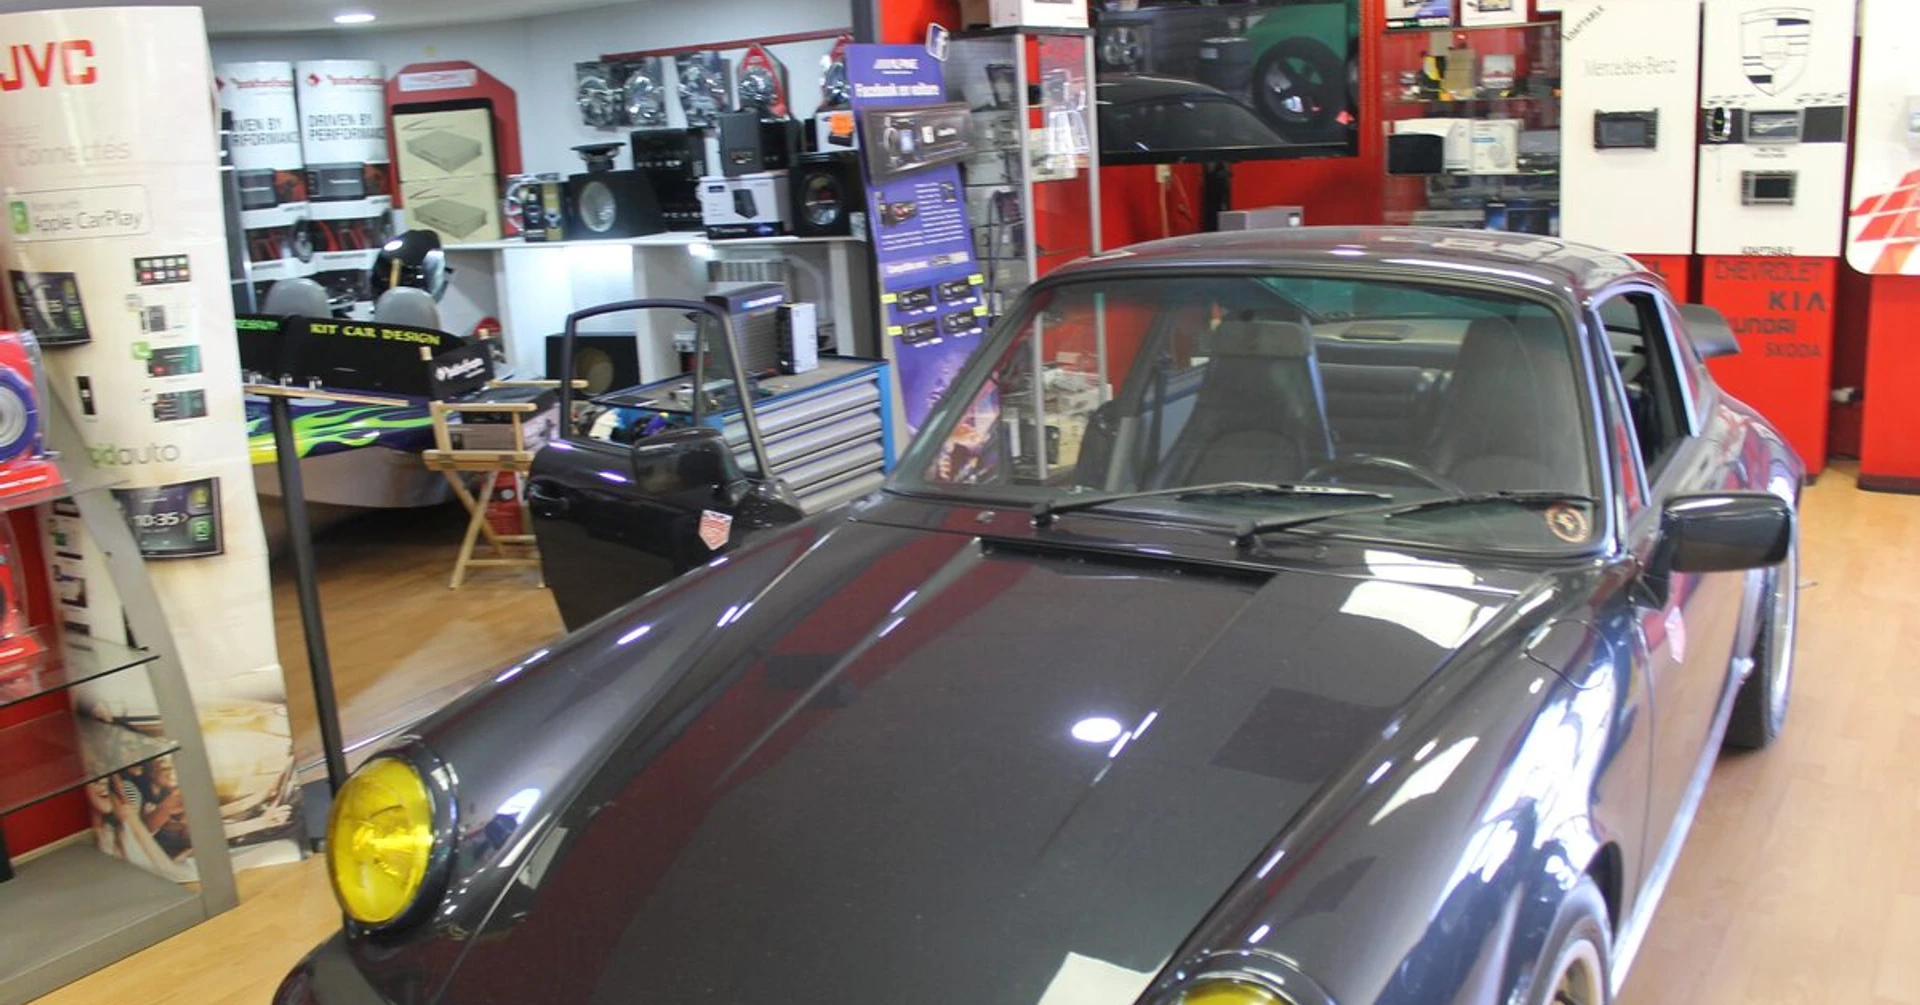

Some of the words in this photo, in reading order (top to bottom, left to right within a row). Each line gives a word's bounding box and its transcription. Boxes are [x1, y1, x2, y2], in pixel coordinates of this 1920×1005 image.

[0, 39, 98, 91] JVC
[77, 208, 143, 230] CarPlay
[1767, 290, 1827, 312] KIA
[310, 323, 338, 335] KIT
[341, 325, 377, 338] CAR
[381, 328, 440, 345] DESIGN
[132, 511, 180, 528] 10:35
